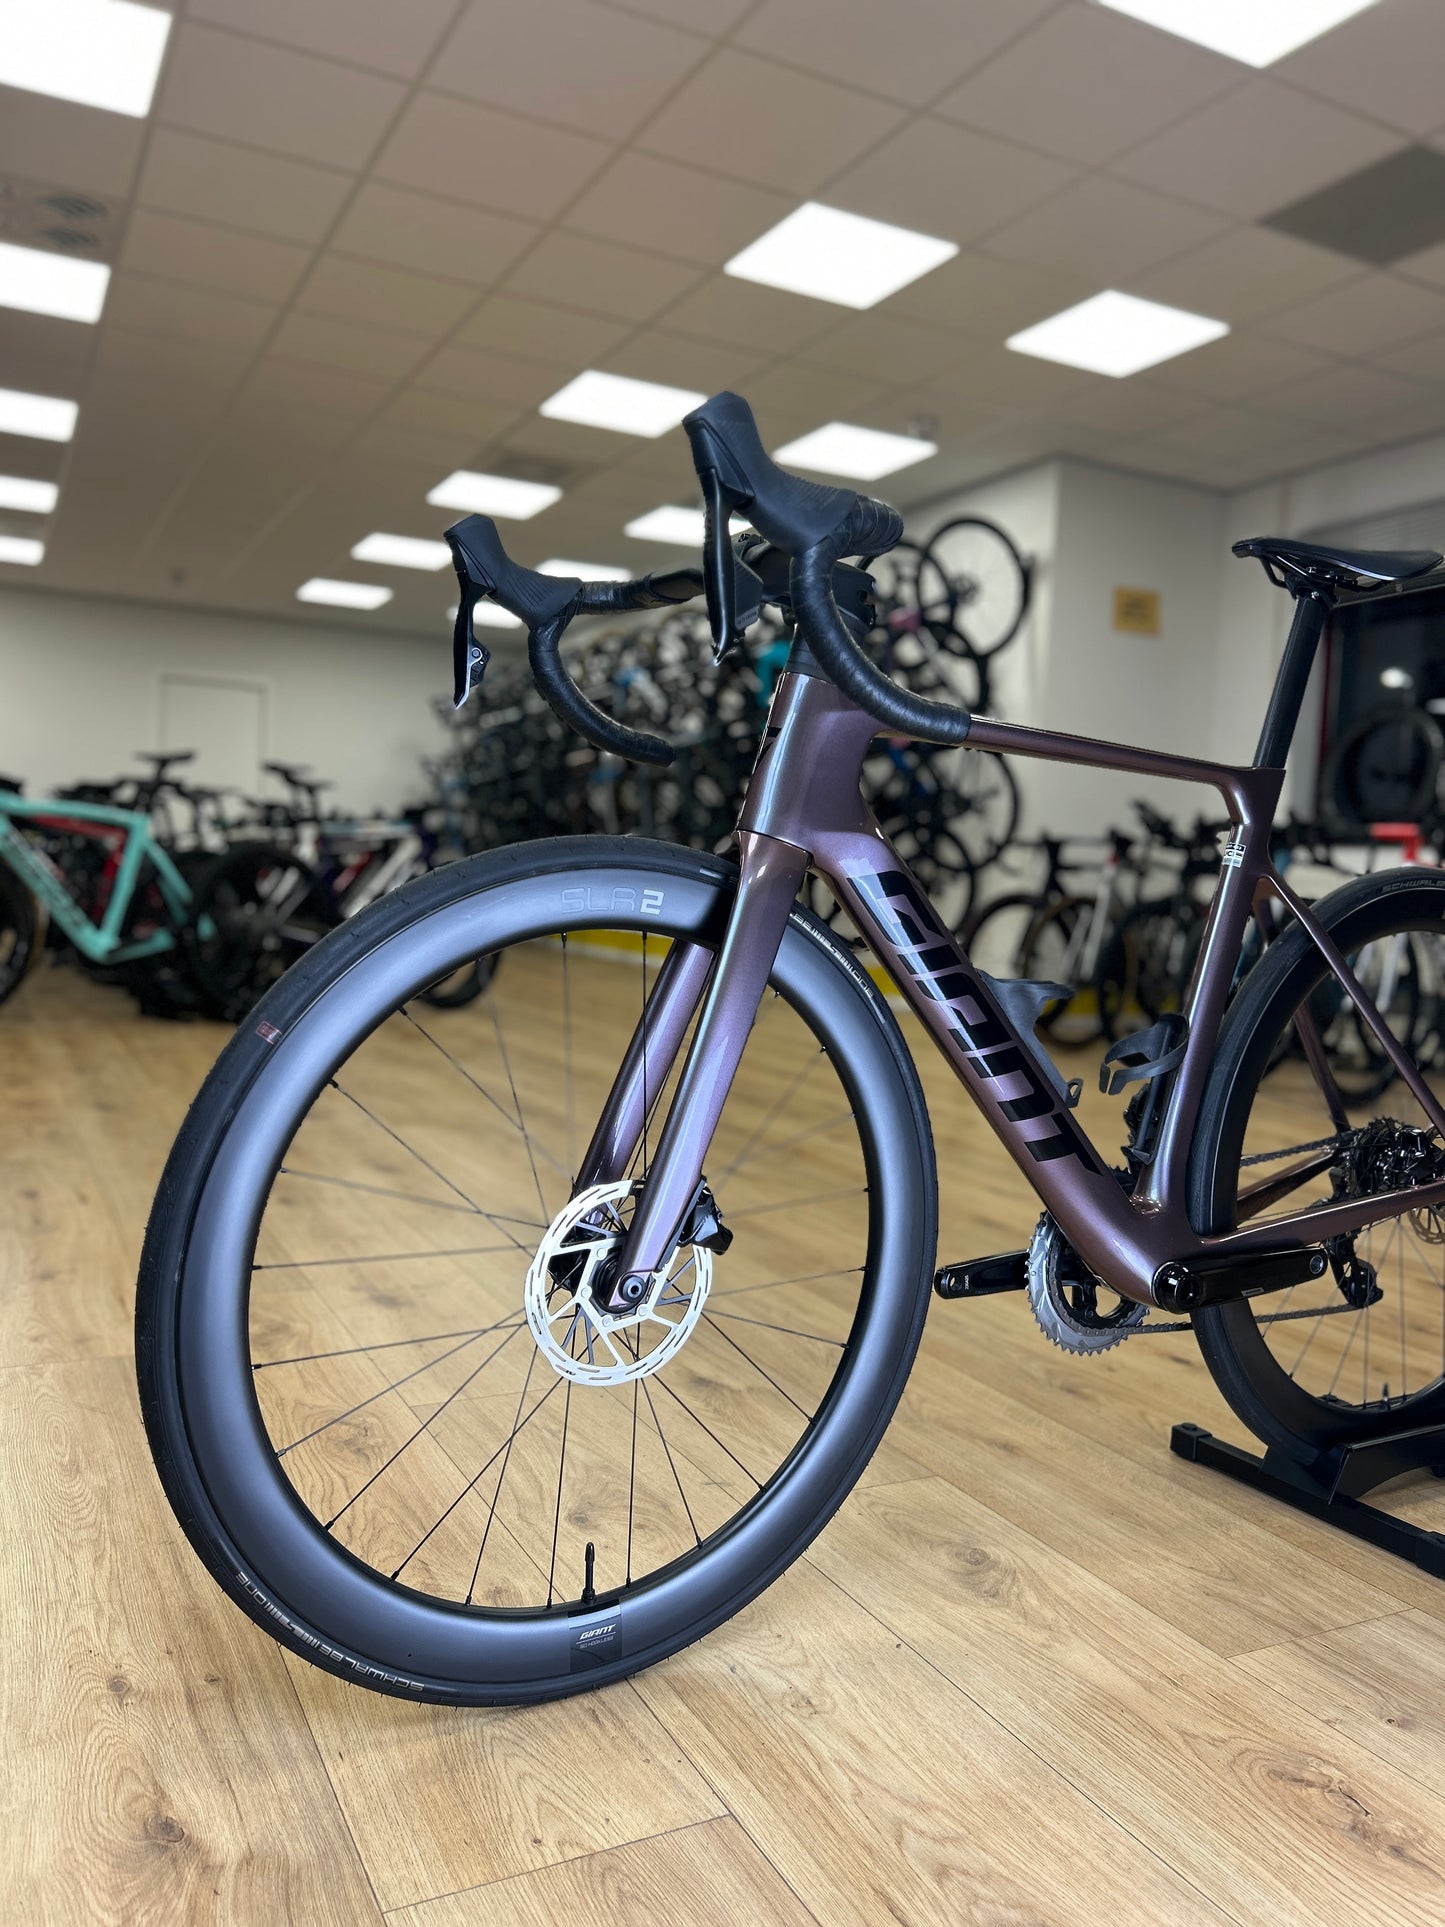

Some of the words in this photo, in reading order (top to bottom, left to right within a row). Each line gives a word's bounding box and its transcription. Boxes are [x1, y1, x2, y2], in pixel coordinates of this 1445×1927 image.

[846, 870, 1104, 1177] GIANT
[235, 1571, 267, 1606] ONE
[579, 1623, 617, 1640] GIANT
[319, 1643, 425, 1692] SCHWALBE
